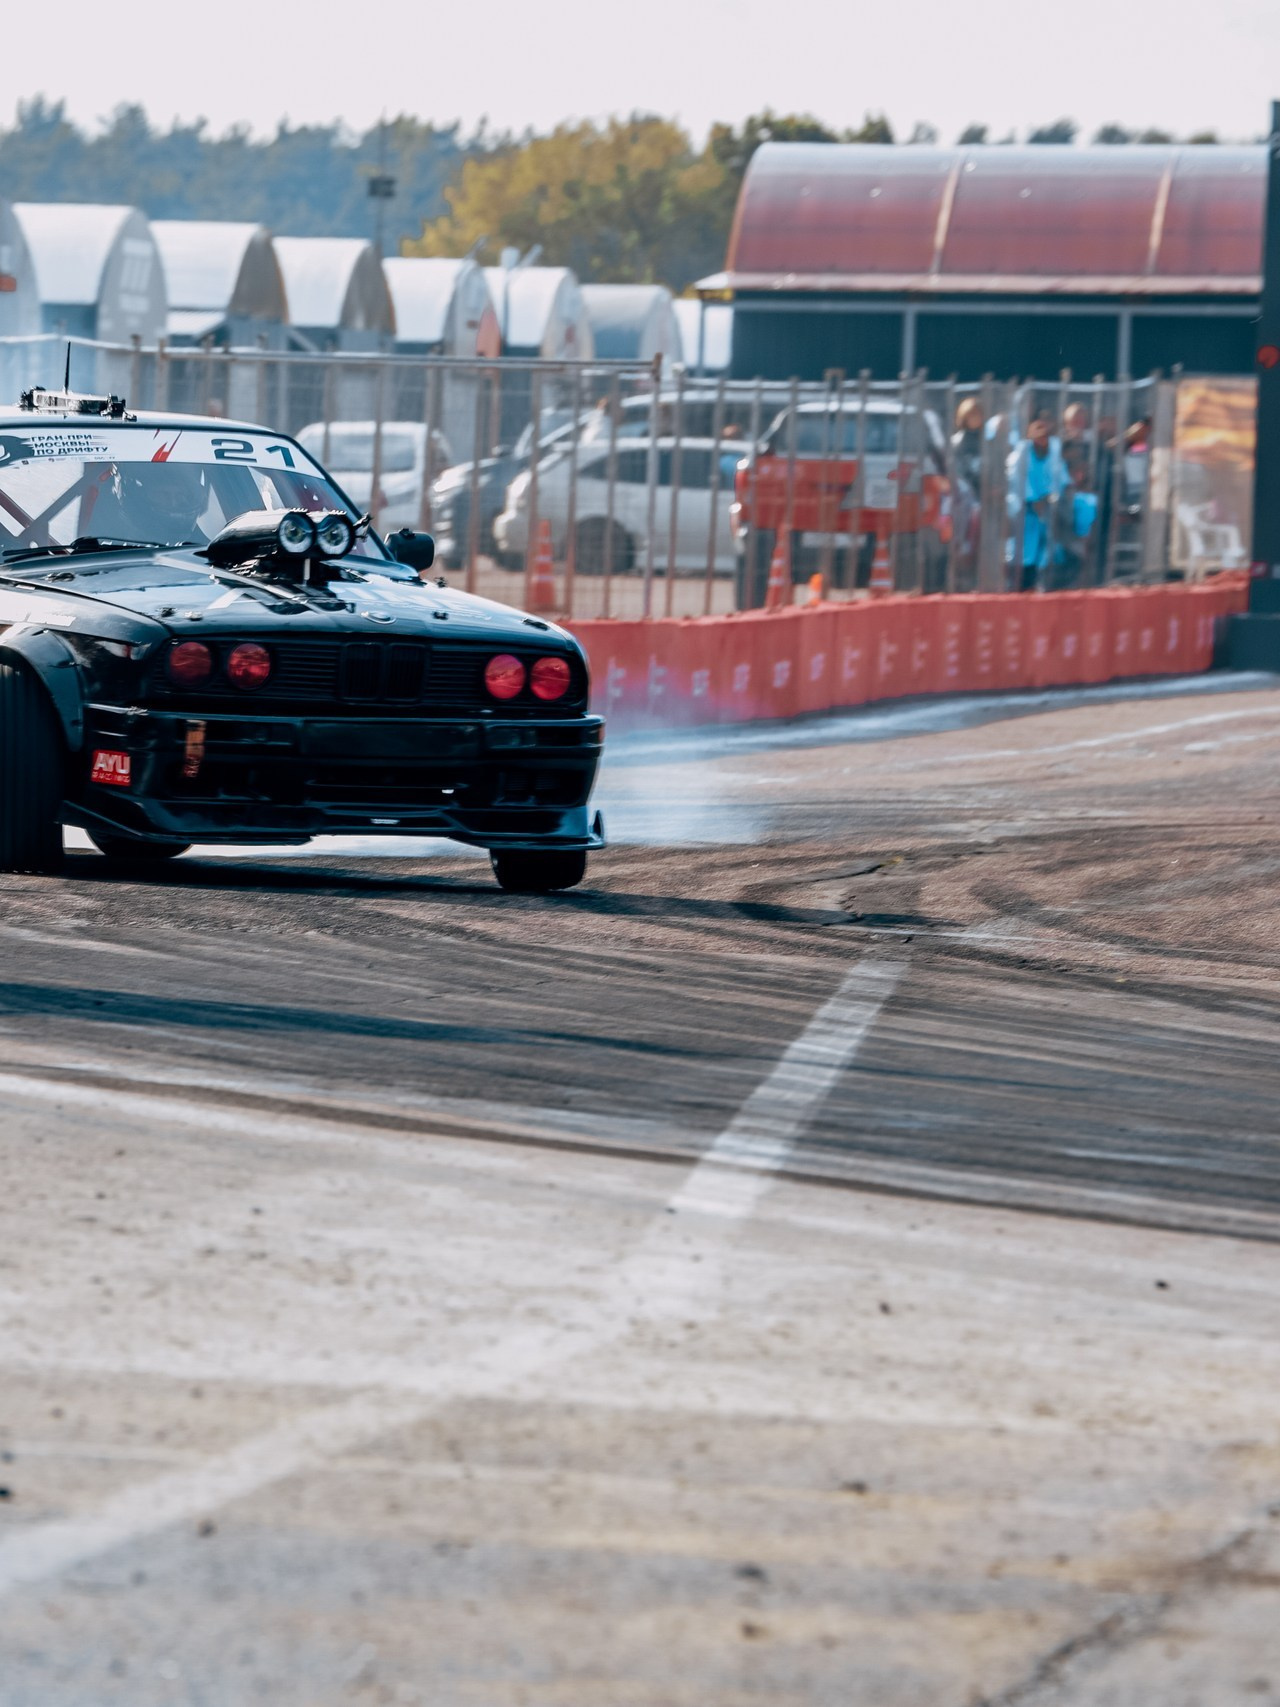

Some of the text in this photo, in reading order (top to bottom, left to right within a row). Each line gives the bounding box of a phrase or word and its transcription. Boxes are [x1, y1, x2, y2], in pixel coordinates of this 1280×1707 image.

[31, 434, 93, 442] ГРАН-ПРИ
[34, 441, 90, 449] МОСКВЫ
[57, 446, 109, 455] ДРИФТУ
[210, 438, 296, 468] 21
[92, 752, 131, 775] AYU
